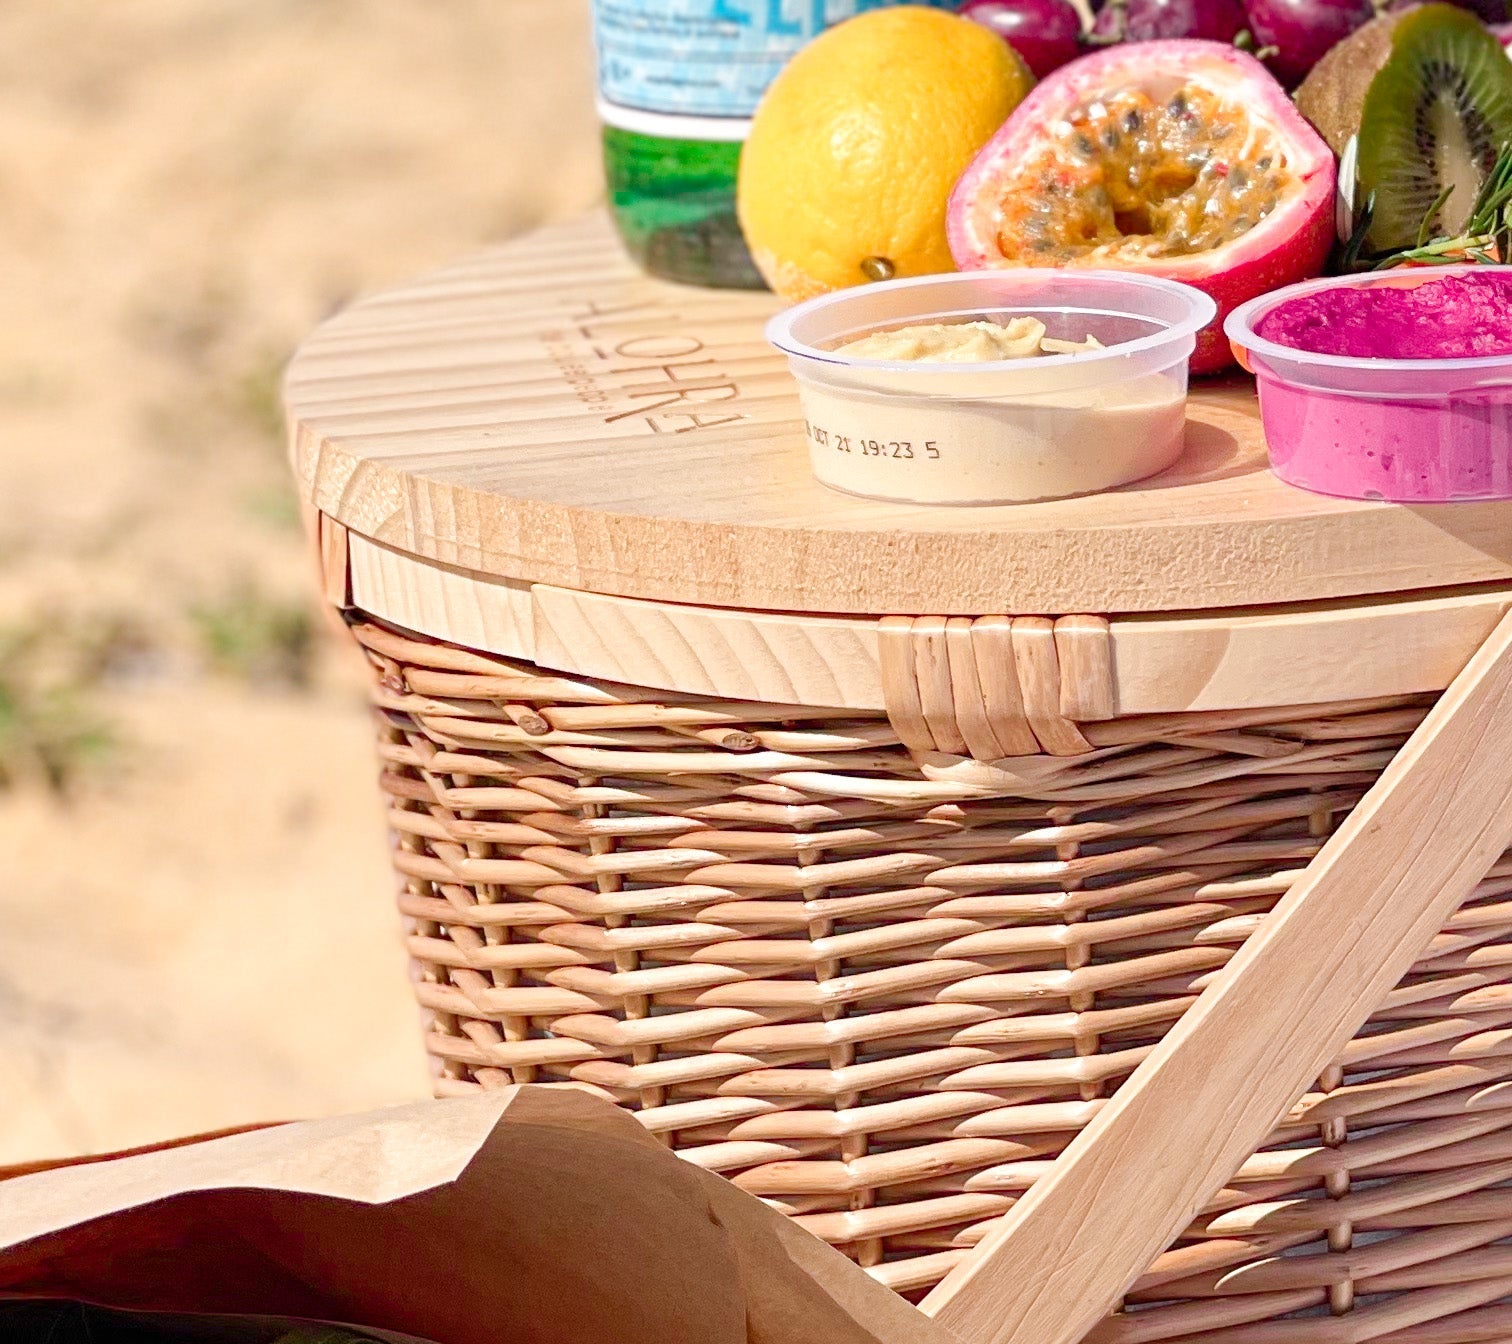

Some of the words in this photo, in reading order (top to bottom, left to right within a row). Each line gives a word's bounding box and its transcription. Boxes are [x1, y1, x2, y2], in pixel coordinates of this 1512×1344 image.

[813, 425, 829, 446] OCT
[835, 435, 851, 453] 21
[860, 440, 914, 459] 19:23
[925, 441, 941, 459] 5
